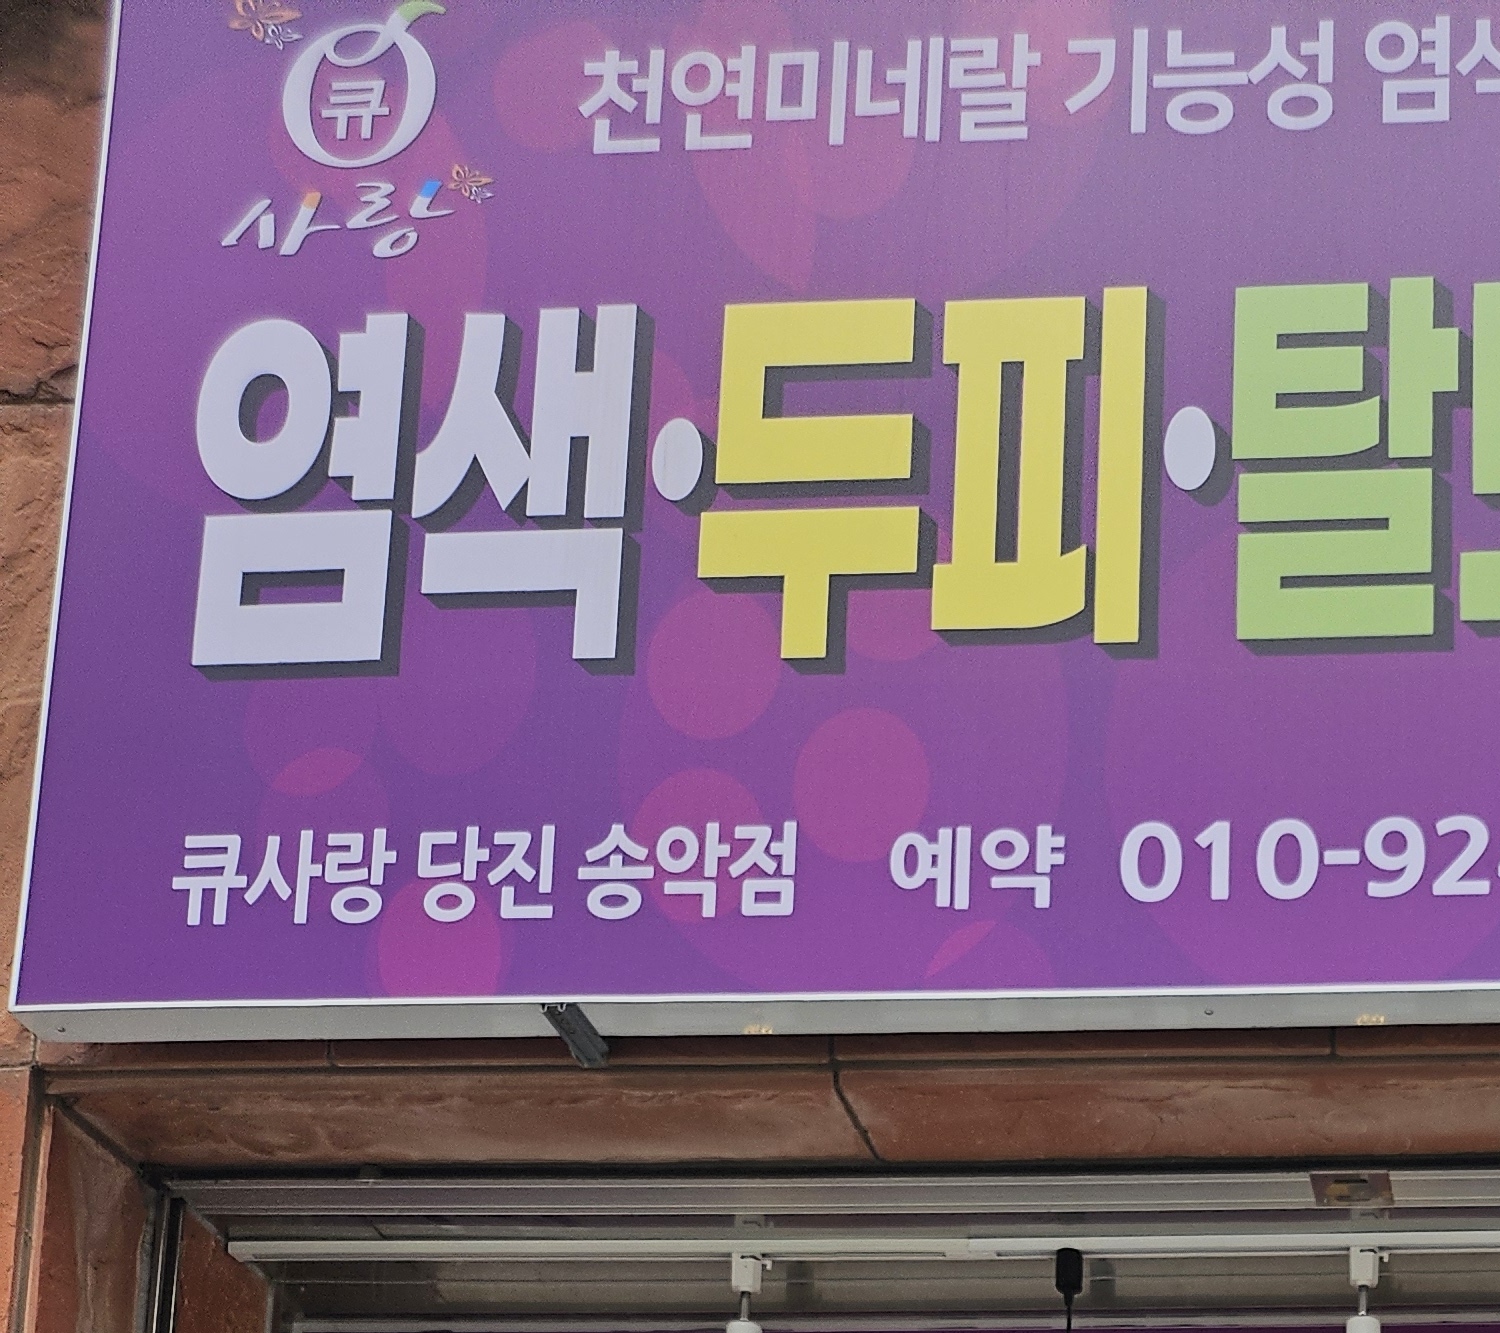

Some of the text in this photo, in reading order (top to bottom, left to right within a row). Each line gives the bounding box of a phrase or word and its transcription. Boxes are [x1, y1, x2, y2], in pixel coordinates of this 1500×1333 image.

[321, 79, 390, 140] 큐
[579, 35, 1041, 155] 천연미네랄
[1064, 19, 1334, 135] 기능성
[221, 180, 456, 258] 사랑
[172, 828, 396, 926] 큐사랑
[417, 824, 556, 923] 당진
[578, 820, 799, 920] 송악점
[890, 824, 1065, 910] 예약
